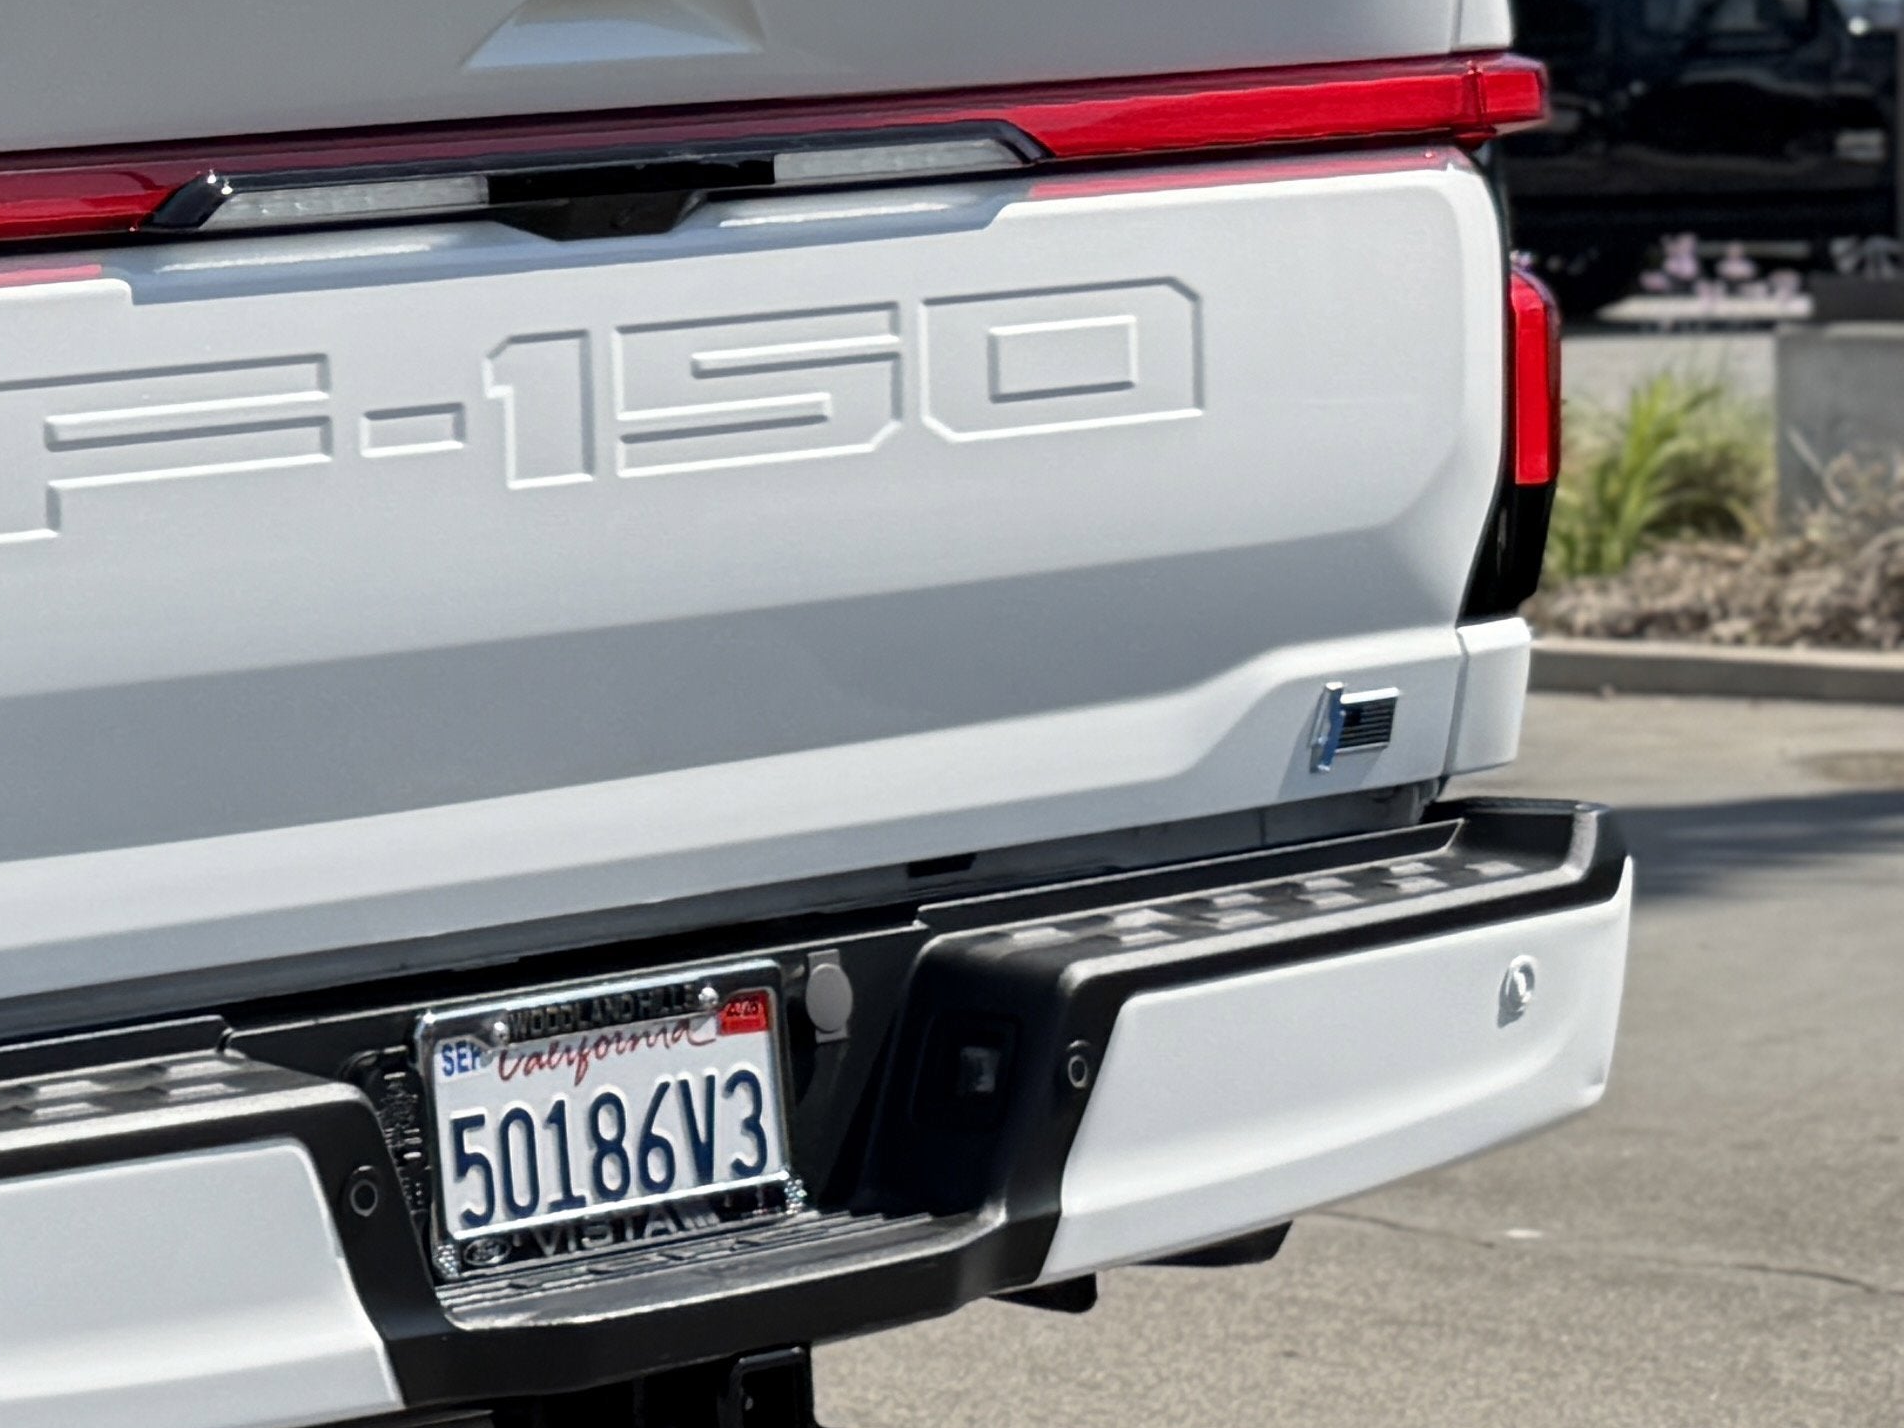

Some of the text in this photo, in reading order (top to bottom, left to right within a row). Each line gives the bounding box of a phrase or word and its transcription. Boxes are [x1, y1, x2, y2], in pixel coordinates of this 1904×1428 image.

[498, 1018, 717, 1086] California
[450, 1069, 769, 1228] 50186V3
[532, 1202, 679, 1257] VISTA
